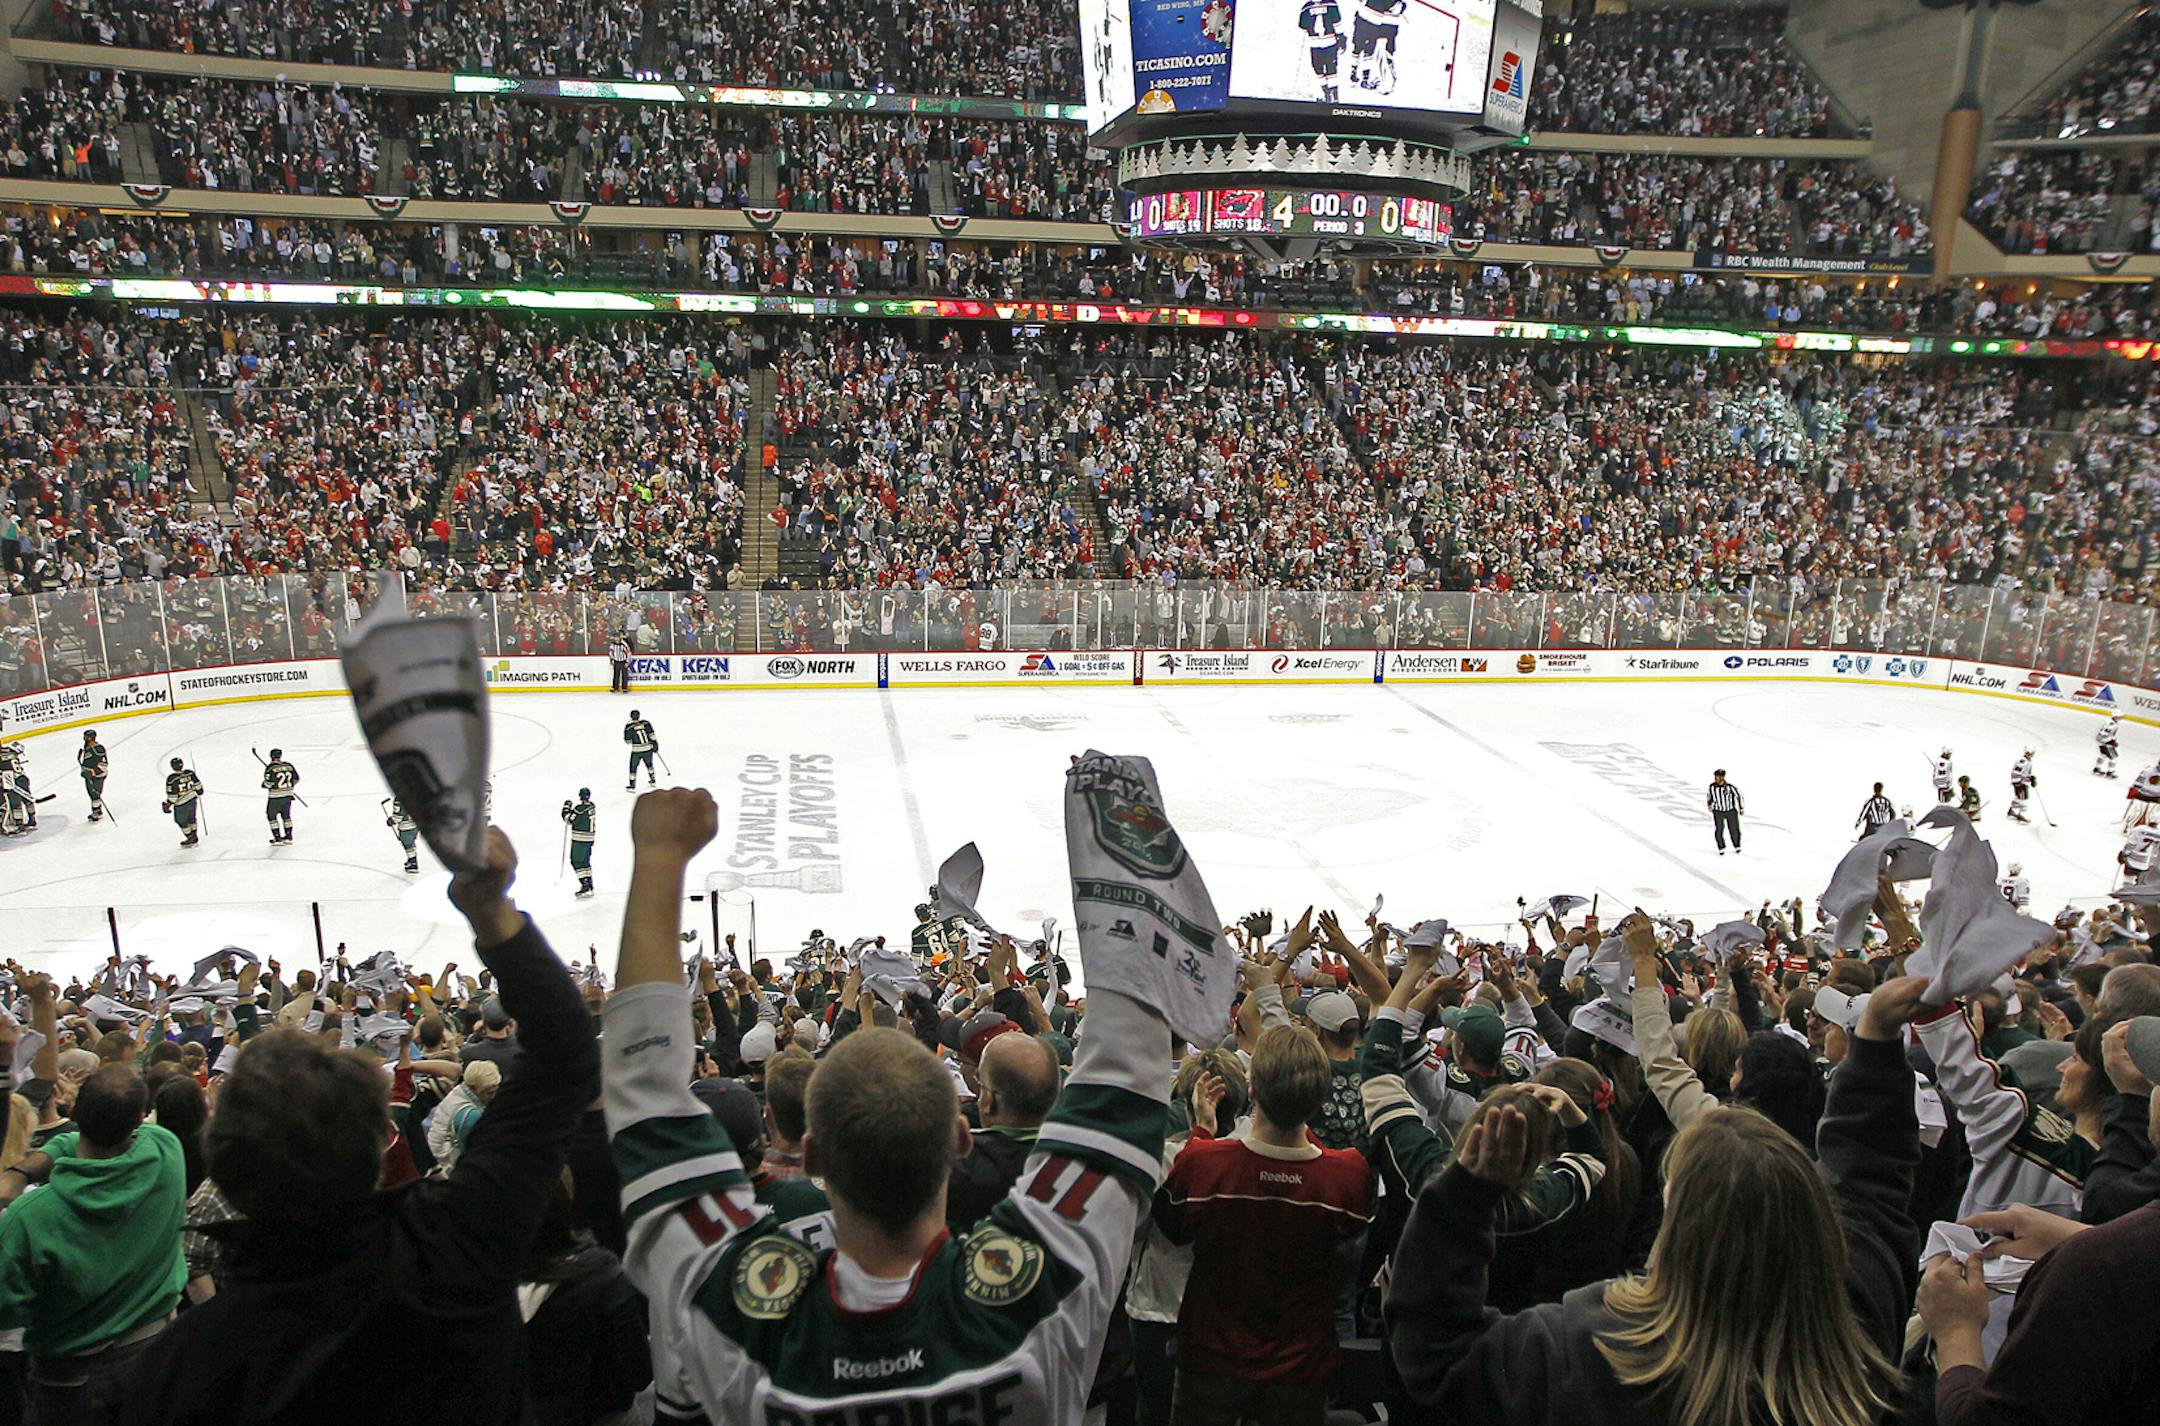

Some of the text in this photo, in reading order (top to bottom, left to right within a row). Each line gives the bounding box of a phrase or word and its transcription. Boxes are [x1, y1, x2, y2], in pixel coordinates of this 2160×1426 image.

[1136, 53, 1227, 72] TICASINO.COM
[1332, 109, 1382, 119] DAKTRONICS
[1272, 195, 1294, 228] 4
[1310, 193, 1367, 217] 00.0
[1214, 218, 1244, 230] SHOTS
[1314, 220, 1365, 235] PERIOD 3
[1727, 255, 1749, 267] RBC
[1752, 256, 1790, 269] Wealth
[1792, 257, 1866, 272] Management
[1073, 653, 1110, 661] WILD SCORE
[1186, 653, 1249, 667] Treasure Island
[1391, 654, 1457, 668] Andersen
[1640, 658, 1699, 669] StarTribune
[1747, 658, 1809, 668] POLARIS
[682, 658, 729, 673] KFAN
[775, 660, 855, 674] FOX NORTH
[900, 661, 953, 672] WELLS
[956, 660, 1006, 672] FARGO
[1111, 662, 1125, 671] GAS
[1294, 658, 1360, 672] Xcel Energy
[180, 669, 308, 690] STATEOFHOCKEYSTORE.COM
[499, 671, 581, 683] IMAGING PATH
[1951, 673, 2007, 689] NHL.COM
[12, 687, 90, 717] Treasure Island
[104, 689, 166, 710] NHL.COM
[738, 754, 782, 786] CUP
[788, 754, 841, 860] PLAYOFFS
[726, 787, 779, 869] STANLEY
[1093, 884, 1181, 930] ROUND TWO
[1260, 1171, 1302, 1184] Reebok
[833, 1349, 925, 1380] Reebok
